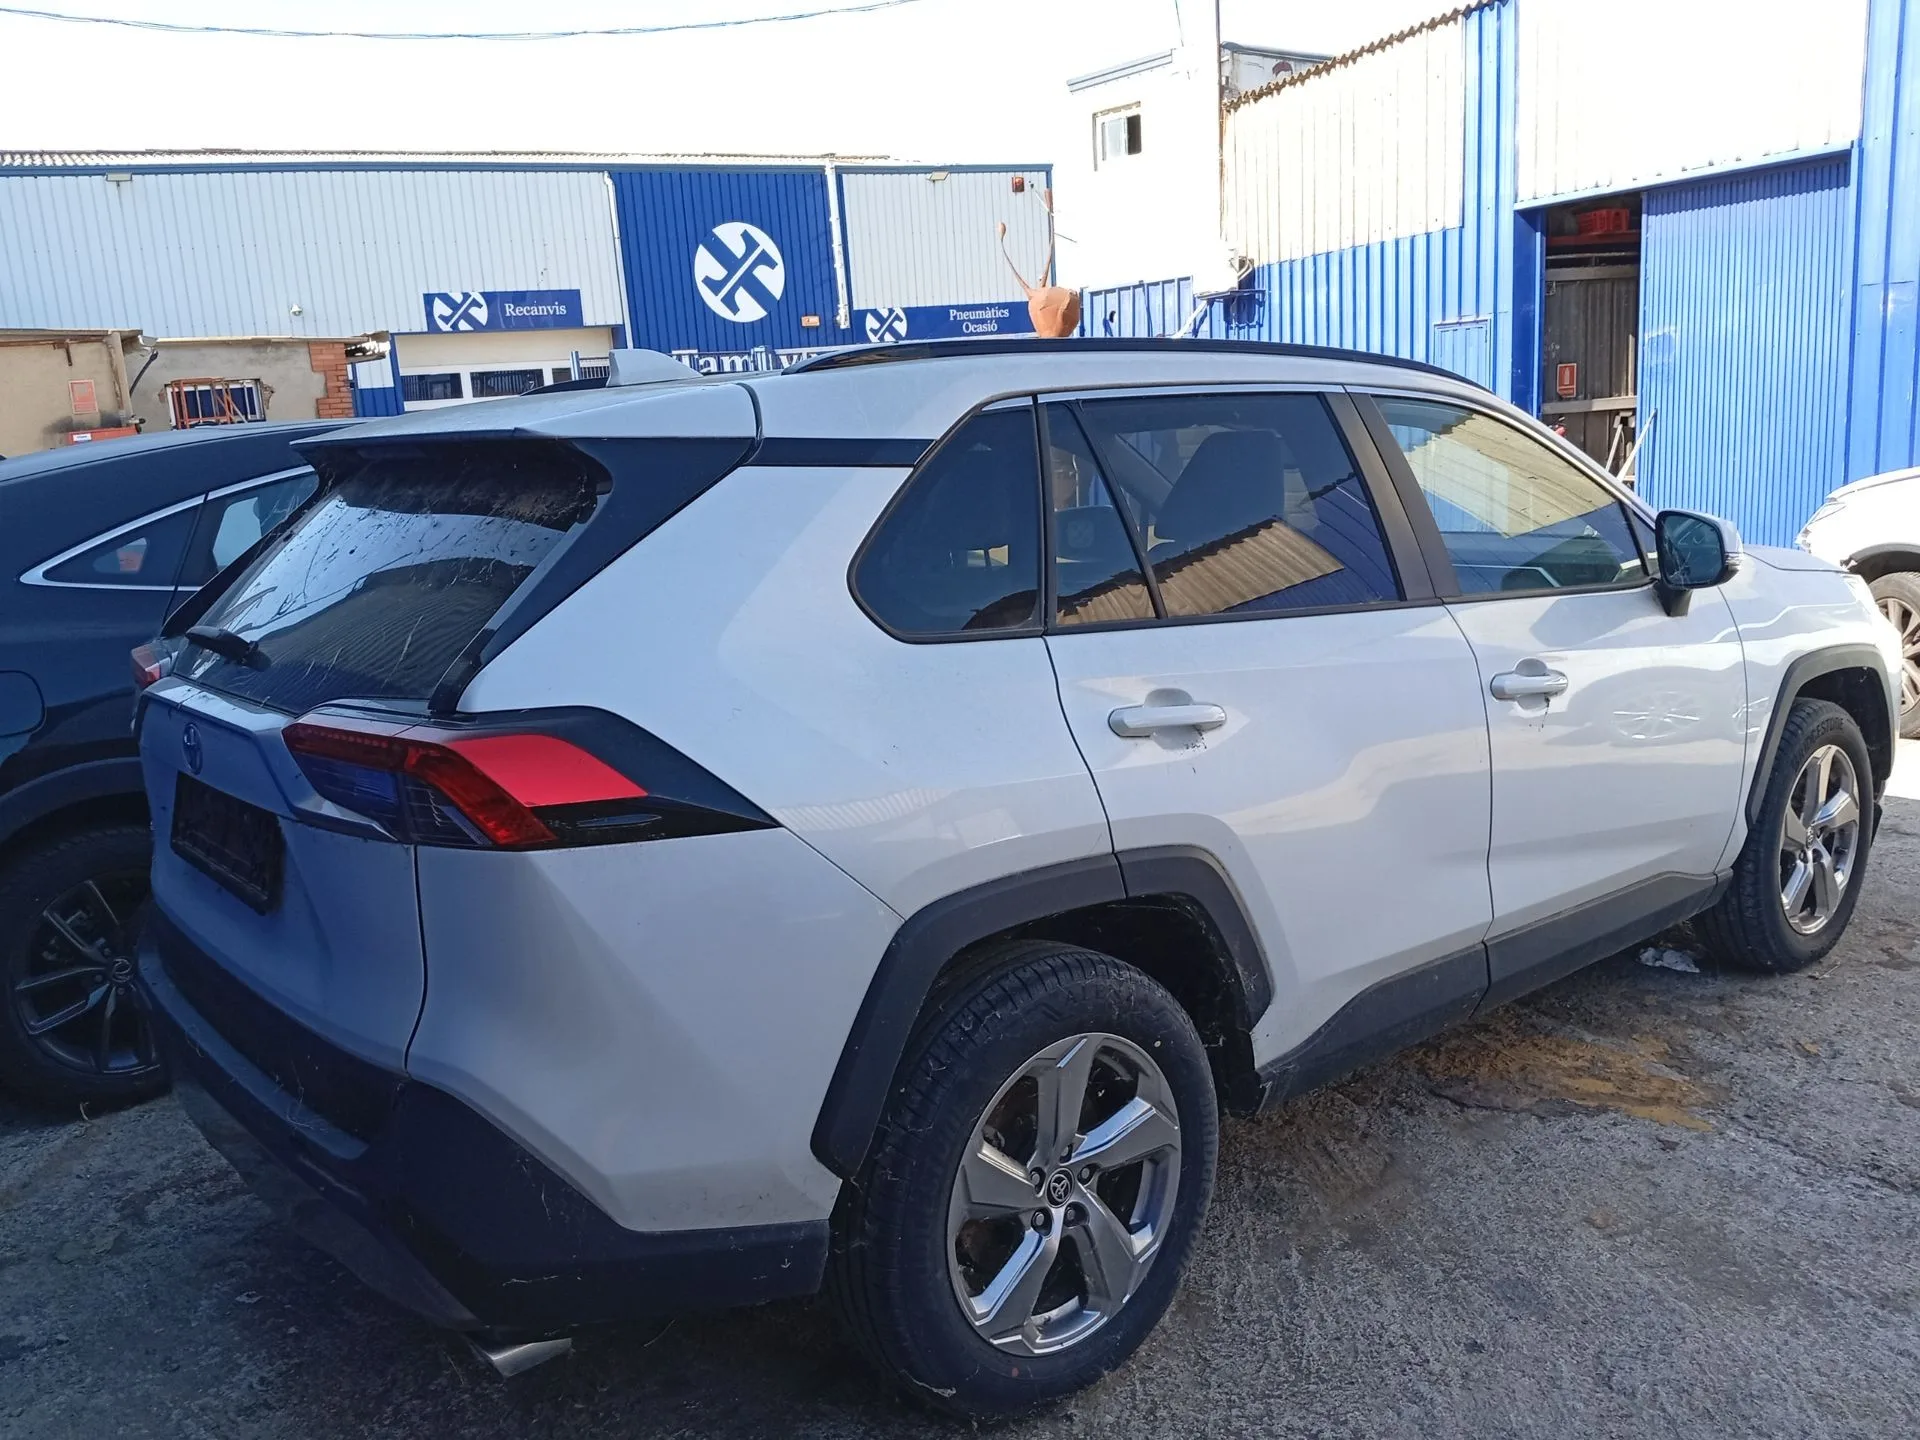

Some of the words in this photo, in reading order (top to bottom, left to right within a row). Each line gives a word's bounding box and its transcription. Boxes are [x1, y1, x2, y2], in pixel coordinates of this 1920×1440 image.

[504, 300, 567, 317] Recanvis
[948, 306, 1010, 321] Pneumàtics
[962, 320, 998, 334] Ocasió
